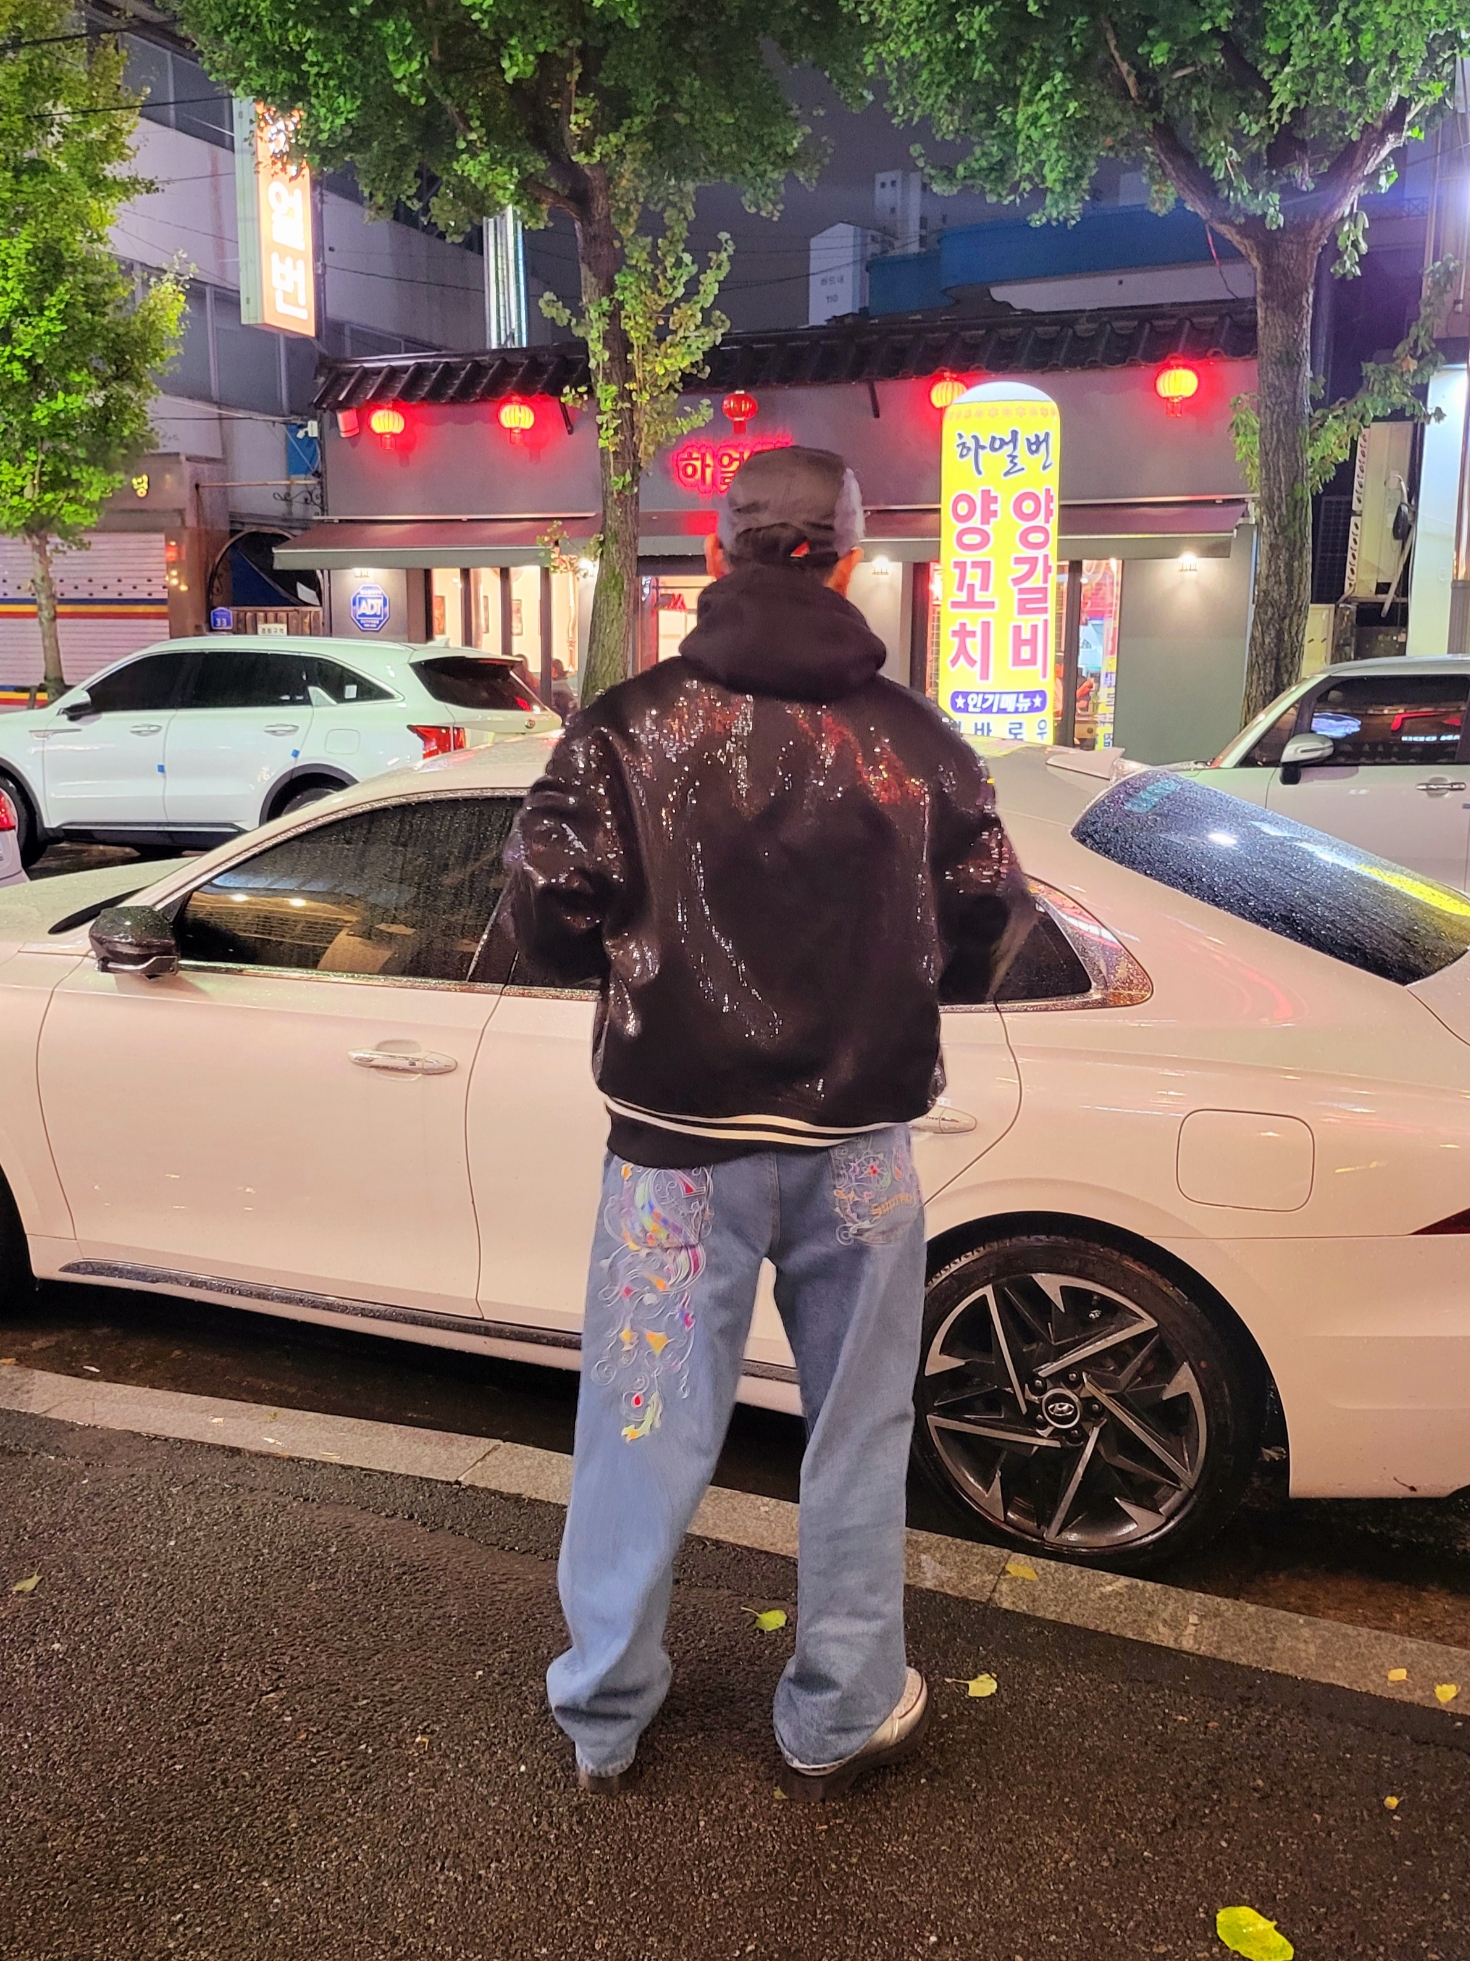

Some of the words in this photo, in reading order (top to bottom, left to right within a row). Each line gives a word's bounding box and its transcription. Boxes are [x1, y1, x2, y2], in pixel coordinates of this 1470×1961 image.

[949, 487, 999, 682] 양꼬치
[1010, 487, 1054, 680] 양갈비
[358, 598, 383, 615] ADT
[966, 692, 1032, 714] 인기메뉴
[957, 719, 1048, 741] 바로우
